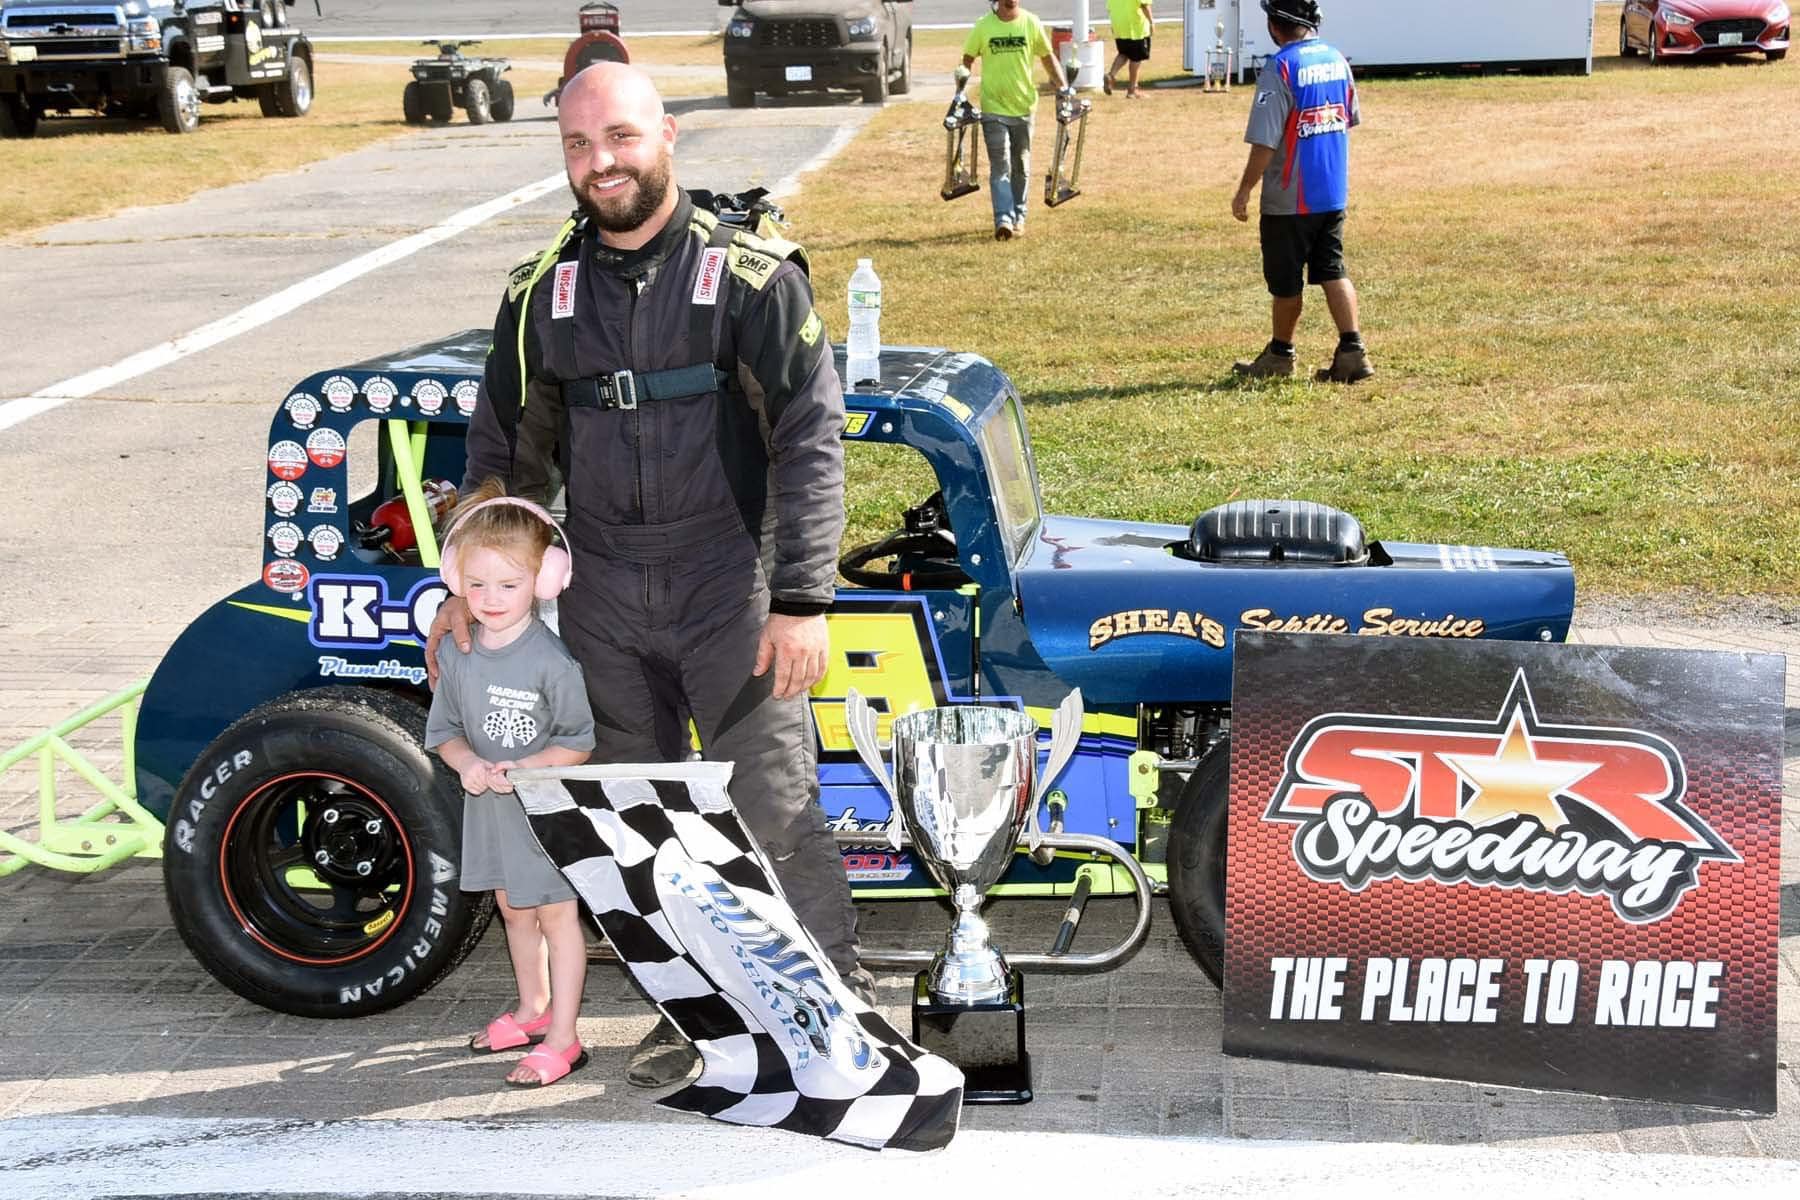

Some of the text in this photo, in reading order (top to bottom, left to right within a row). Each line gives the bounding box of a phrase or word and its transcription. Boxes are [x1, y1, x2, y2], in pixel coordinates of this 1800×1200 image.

[700, 254, 718, 297] SIMPSON
[738, 254, 769, 272] OMP
[558, 269, 571, 311] SIMPSON
[1089, 608, 1226, 649] SHEA'S
[1358, 607, 1485, 638] Service
[319, 658, 427, 685] Plumbing
[486, 684, 540, 702] HARMON
[489, 695, 536, 711] RACING
[1275, 692, 1722, 850] STAR
[173, 749, 254, 854] RACER
[1301, 796, 1688, 908] Speedway
[338, 850, 458, 1004] AMERICAN
[661, 871, 731, 935] AUTO
[730, 943, 811, 1072] SERVICE
[1269, 957, 1724, 1029] THE PLACE TO RACE
